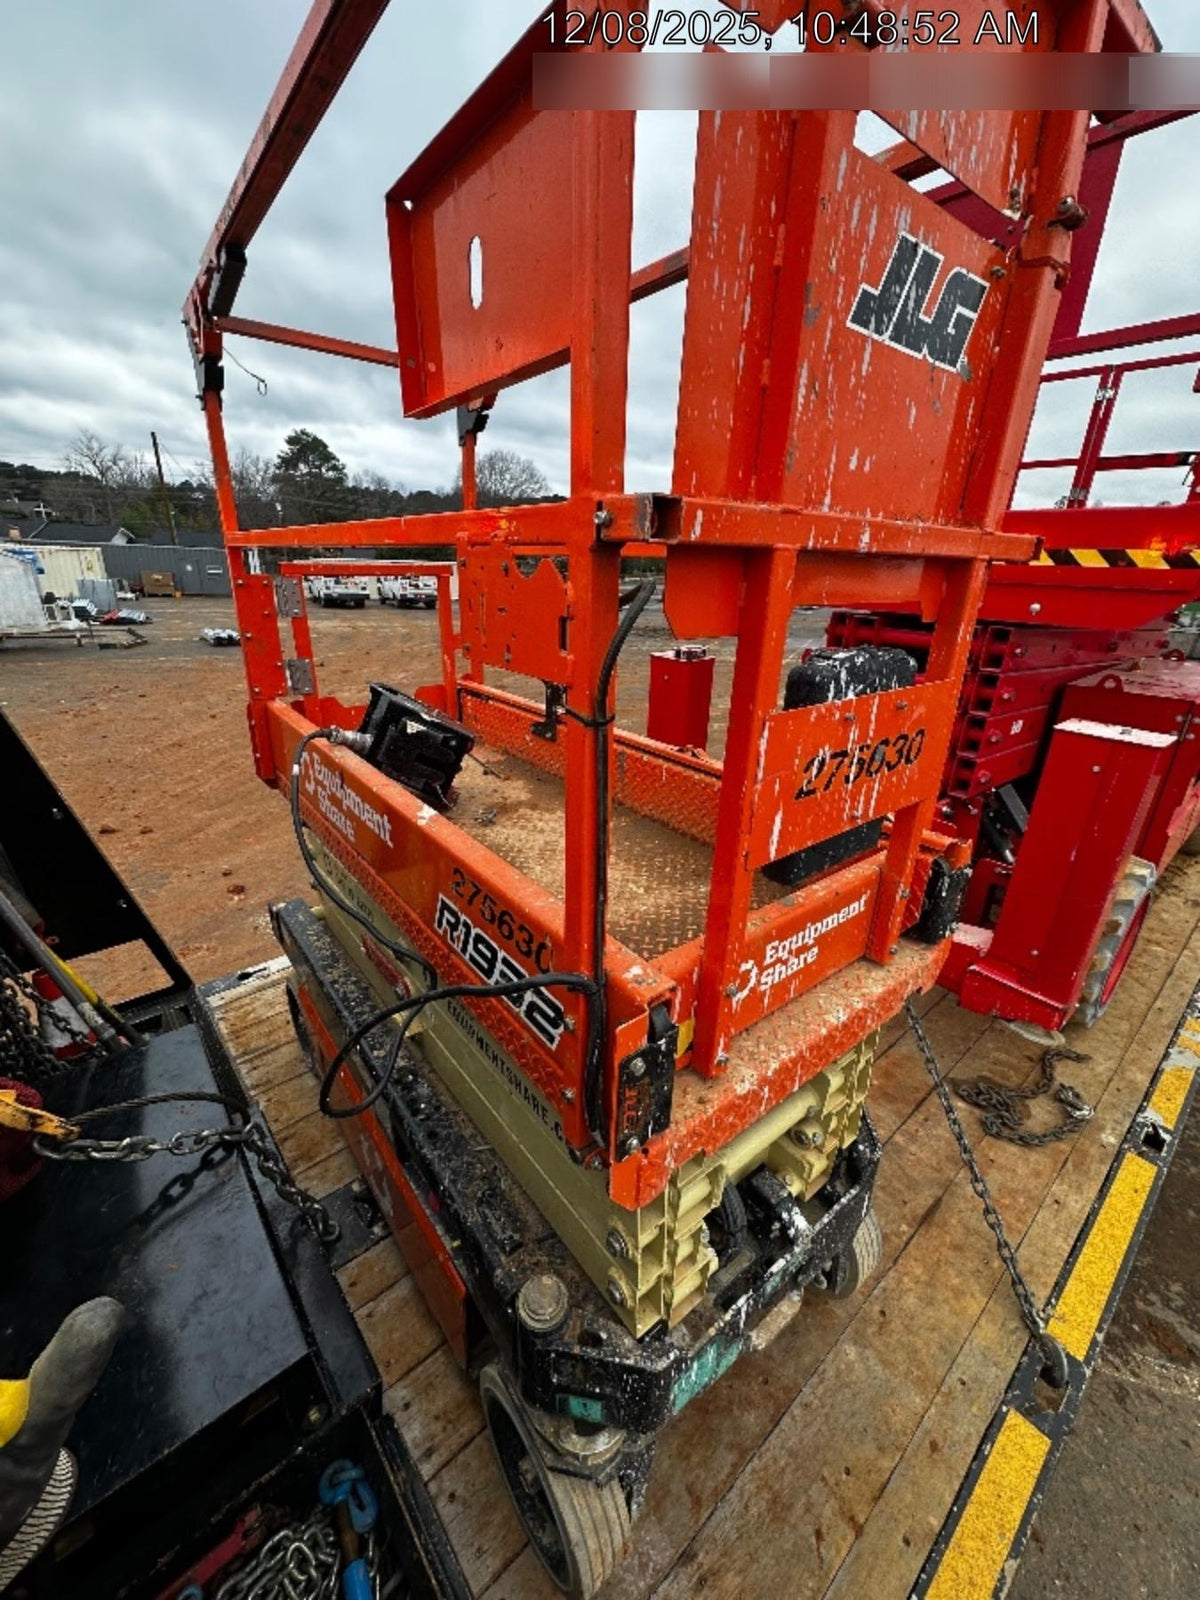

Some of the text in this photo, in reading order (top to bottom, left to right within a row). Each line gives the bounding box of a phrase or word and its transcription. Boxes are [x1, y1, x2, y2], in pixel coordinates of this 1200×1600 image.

[846, 231, 991, 373] JLG
[795, 728, 926, 800] 275630
[764, 894, 867, 967] Equipment
[760, 945, 818, 992] Share
